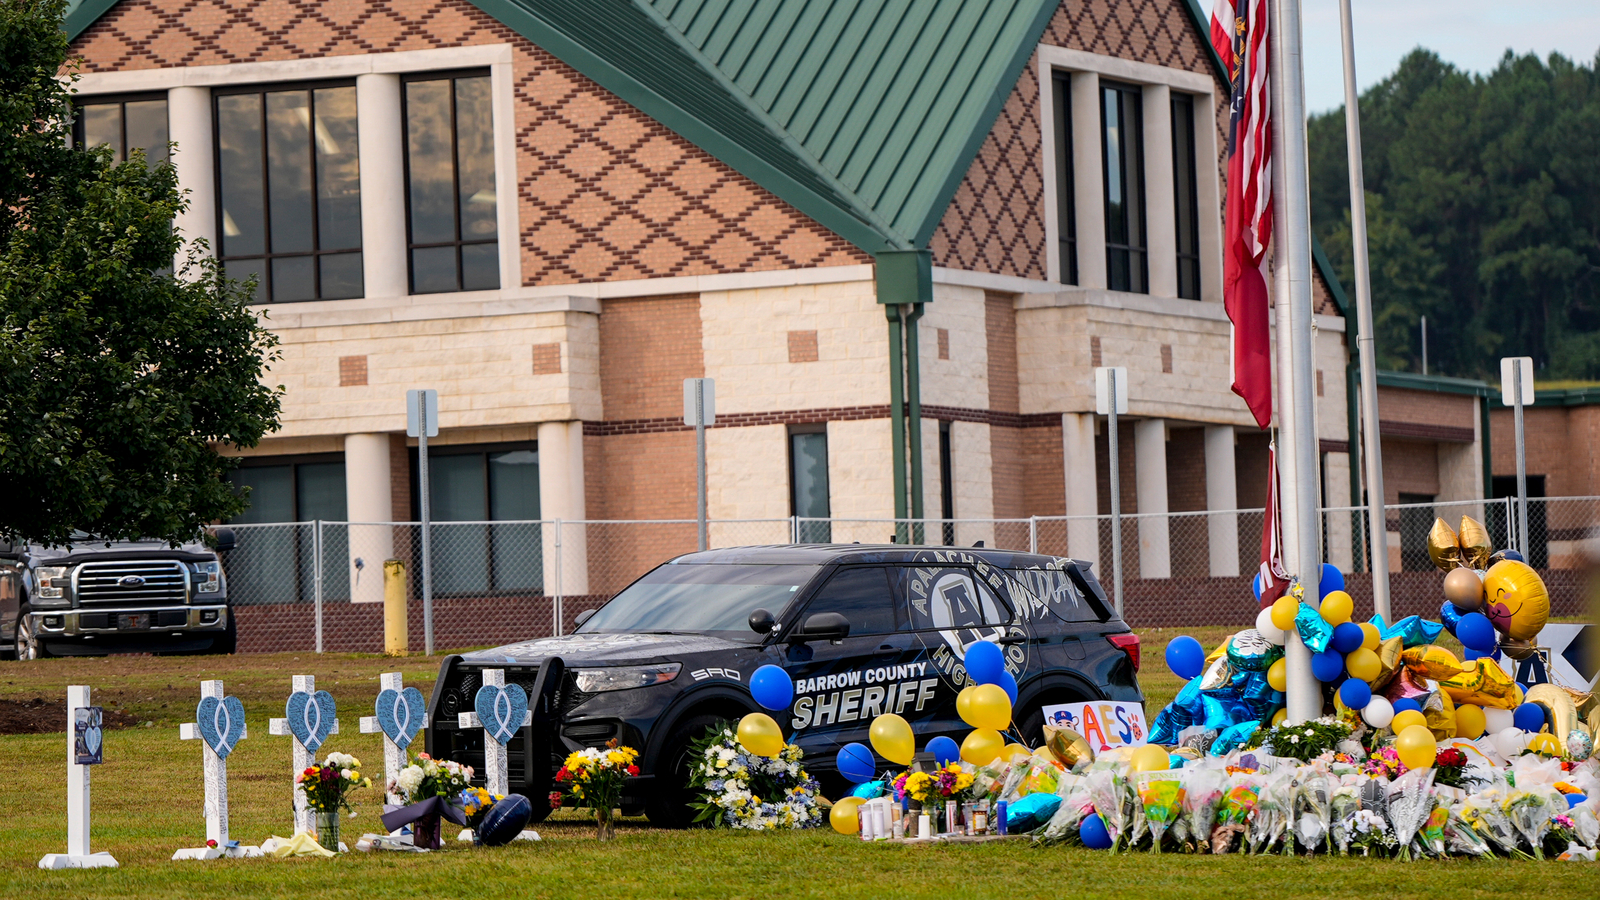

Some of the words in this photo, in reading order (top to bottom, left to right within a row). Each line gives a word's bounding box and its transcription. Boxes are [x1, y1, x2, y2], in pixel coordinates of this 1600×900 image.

[911, 550, 1003, 617] APALACHEE
[1002, 556, 1085, 621] WILDCAT
[128, 616, 139, 627] T
[691, 667, 741, 681] SRO
[796, 672, 860, 694] BARROW
[865, 662, 927, 684] COUNTY
[791, 678, 938, 730] SHERIFF
[1083, 704, 1132, 745] AES
